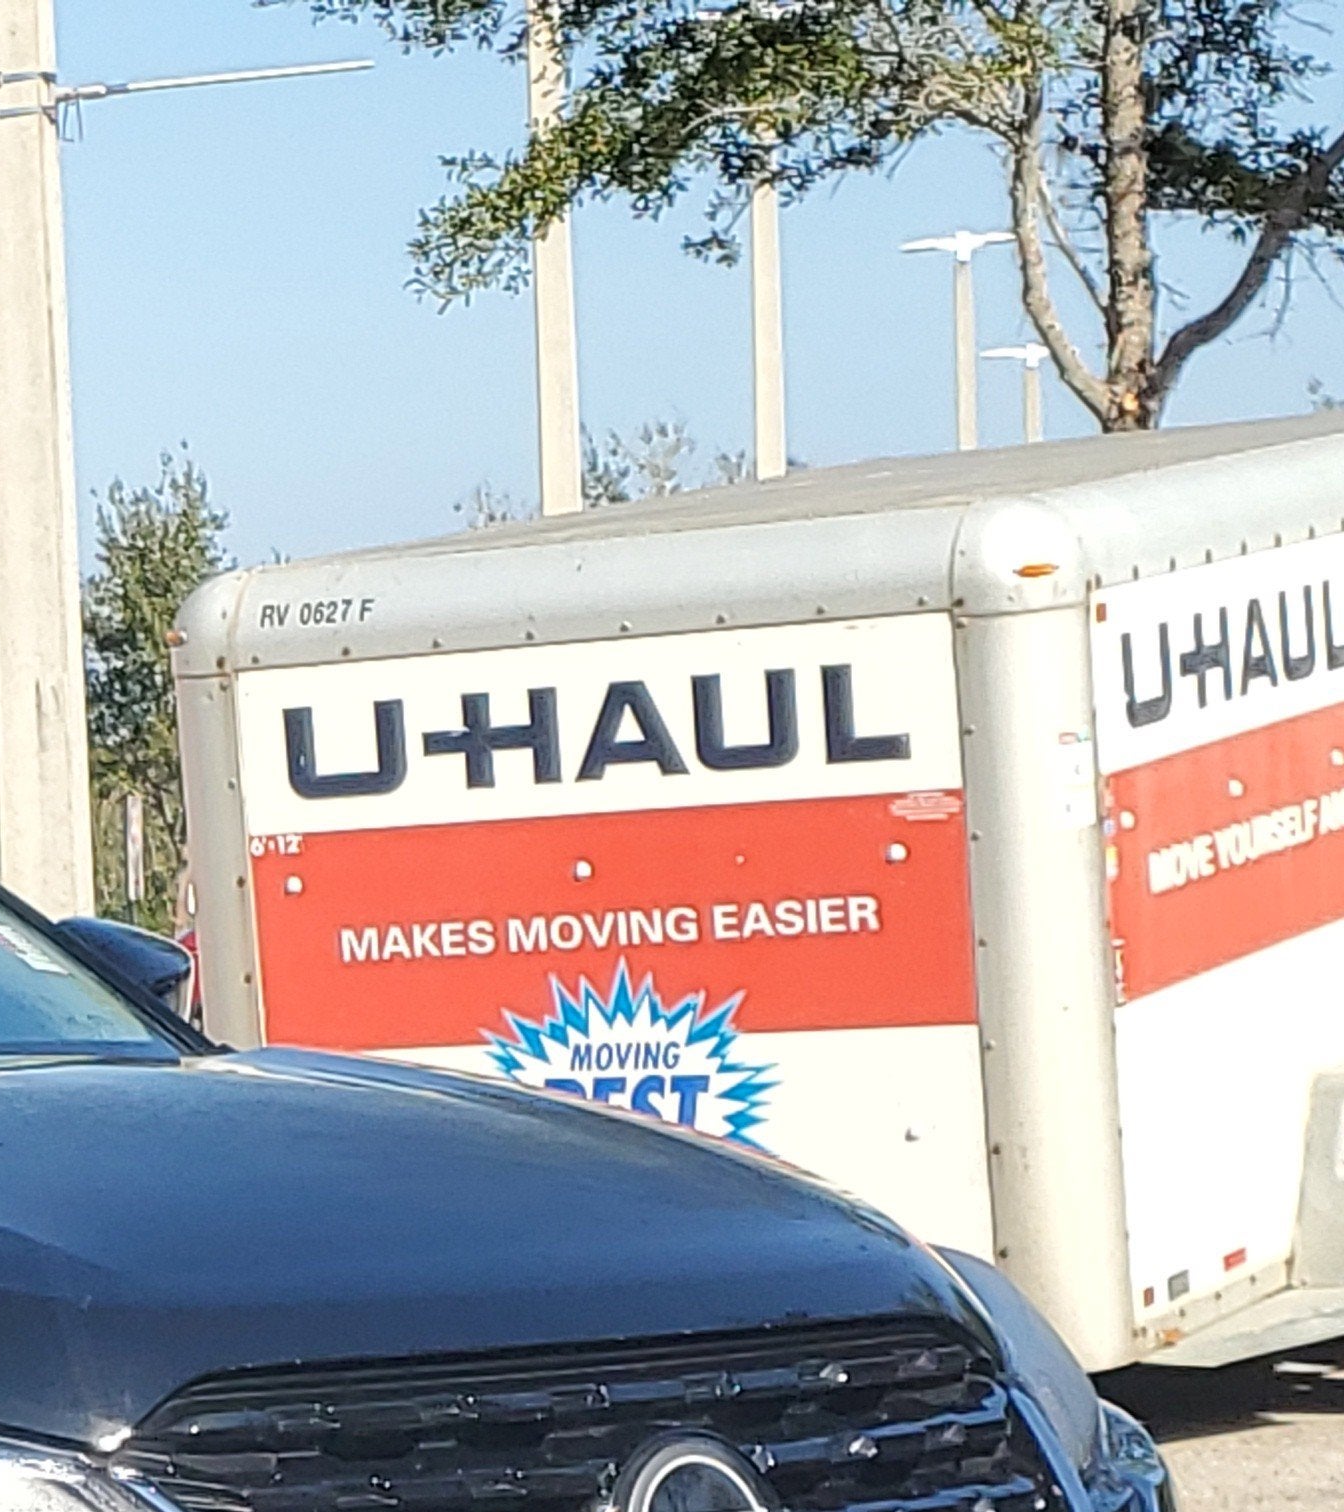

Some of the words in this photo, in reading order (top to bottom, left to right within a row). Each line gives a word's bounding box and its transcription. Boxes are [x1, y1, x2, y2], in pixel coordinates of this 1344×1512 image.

[259, 603, 291, 628] RV
[299, 599, 353, 626] 0627
[358, 598, 375, 622] F
[282, 663, 912, 800] U-HAUL
[1148, 834, 1216, 895] MOVE
[1214, 799, 1318, 869] YOURSELF
[340, 919, 496, 963] MAKES
[507, 906, 699, 954] MOVING
[712, 895, 881, 940] EASIER
[570, 1040, 681, 1071] MOVING
